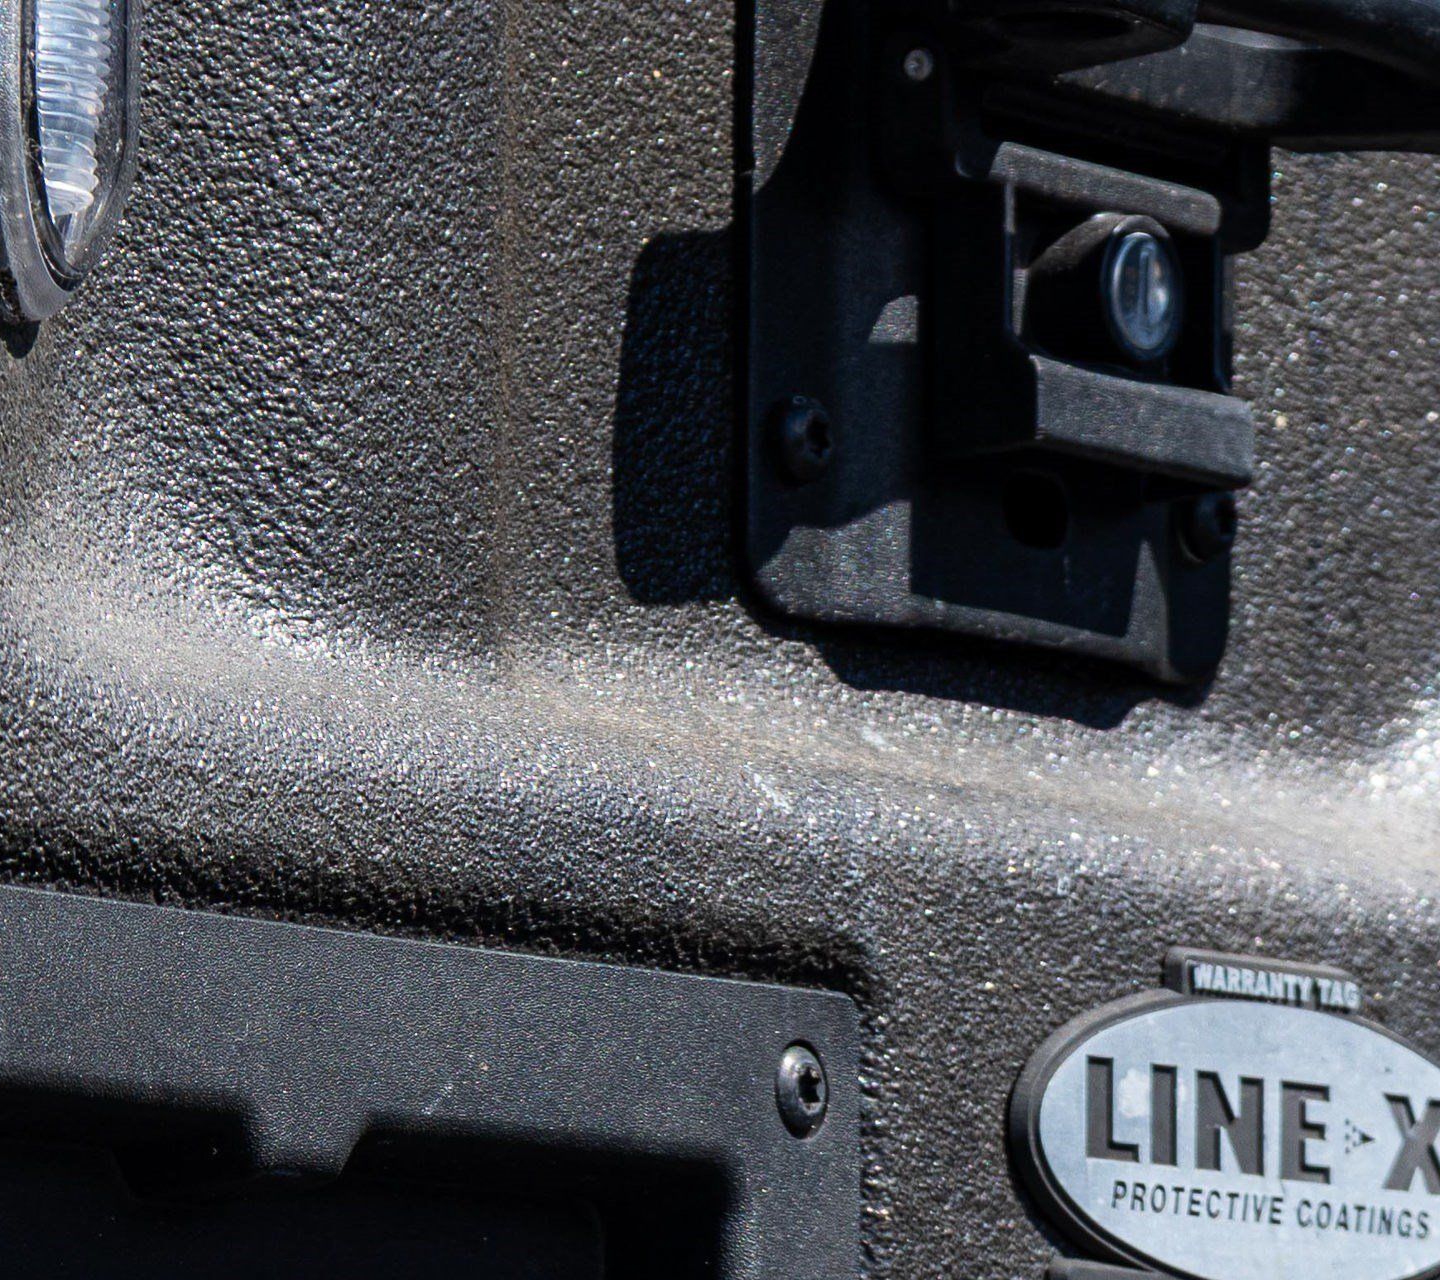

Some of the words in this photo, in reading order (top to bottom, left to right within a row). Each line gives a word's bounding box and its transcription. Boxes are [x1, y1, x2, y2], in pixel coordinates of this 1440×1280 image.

[1194, 963, 1312, 1003] WARRANTY
[1316, 977, 1361, 1010] TAG
[1111, 1180, 1282, 1225] PROTECTIVE
[1296, 1201, 1432, 1240] COATINGS
